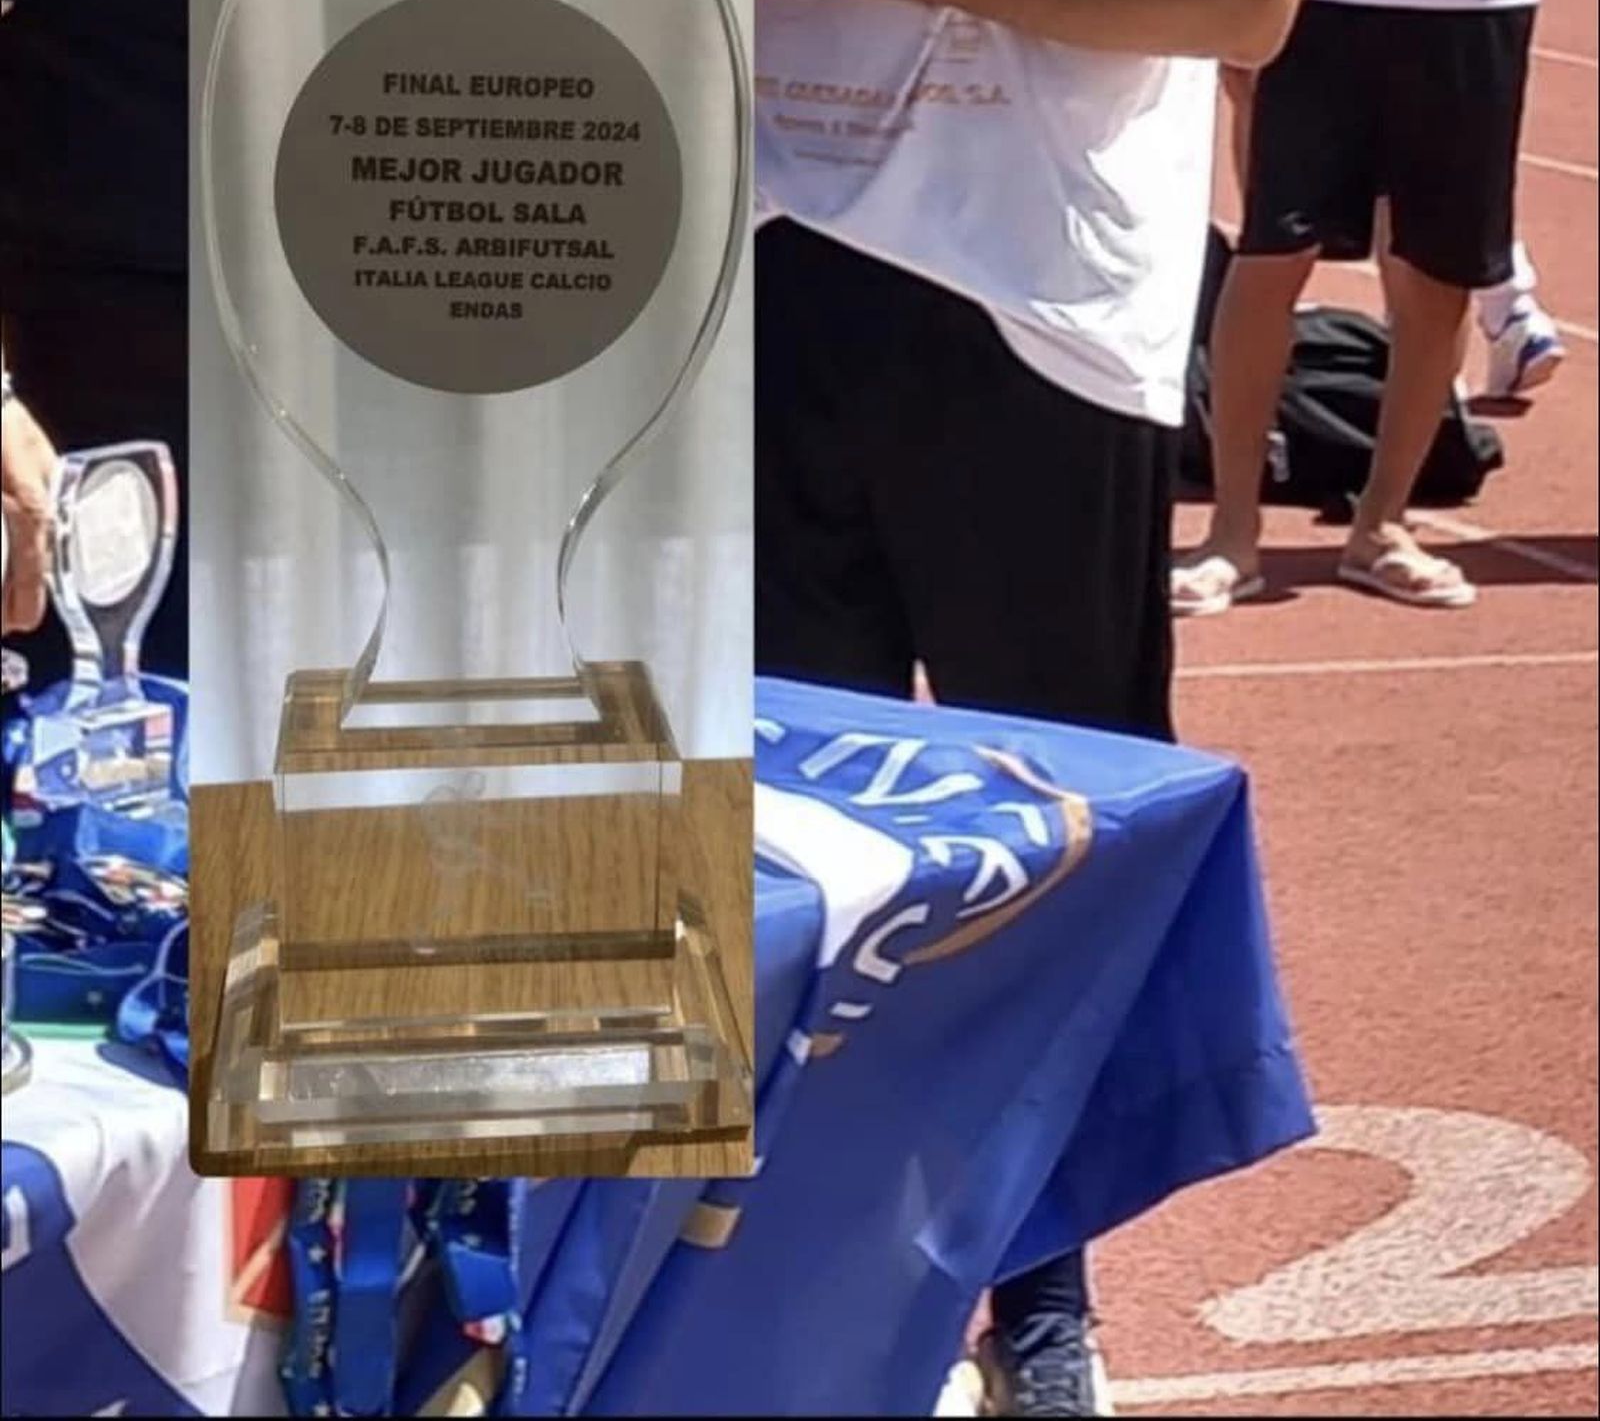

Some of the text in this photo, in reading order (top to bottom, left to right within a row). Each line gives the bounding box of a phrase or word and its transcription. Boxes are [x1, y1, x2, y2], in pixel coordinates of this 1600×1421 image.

[382, 72, 595, 100] FINAL EUROPEO
[329, 114, 641, 142] 7-8 DE SEPTIEMBRE 2024
[351, 155, 624, 187] MEJOR JUGADOR
[389, 194, 587, 225] FÚTBOL SALA
[352, 235, 615, 260] F.A.F.S. ARBIFUTSAL
[354, 269, 612, 292] ITALIA LEAGUE CALCIO
[449, 301, 523, 320] ENDAS
